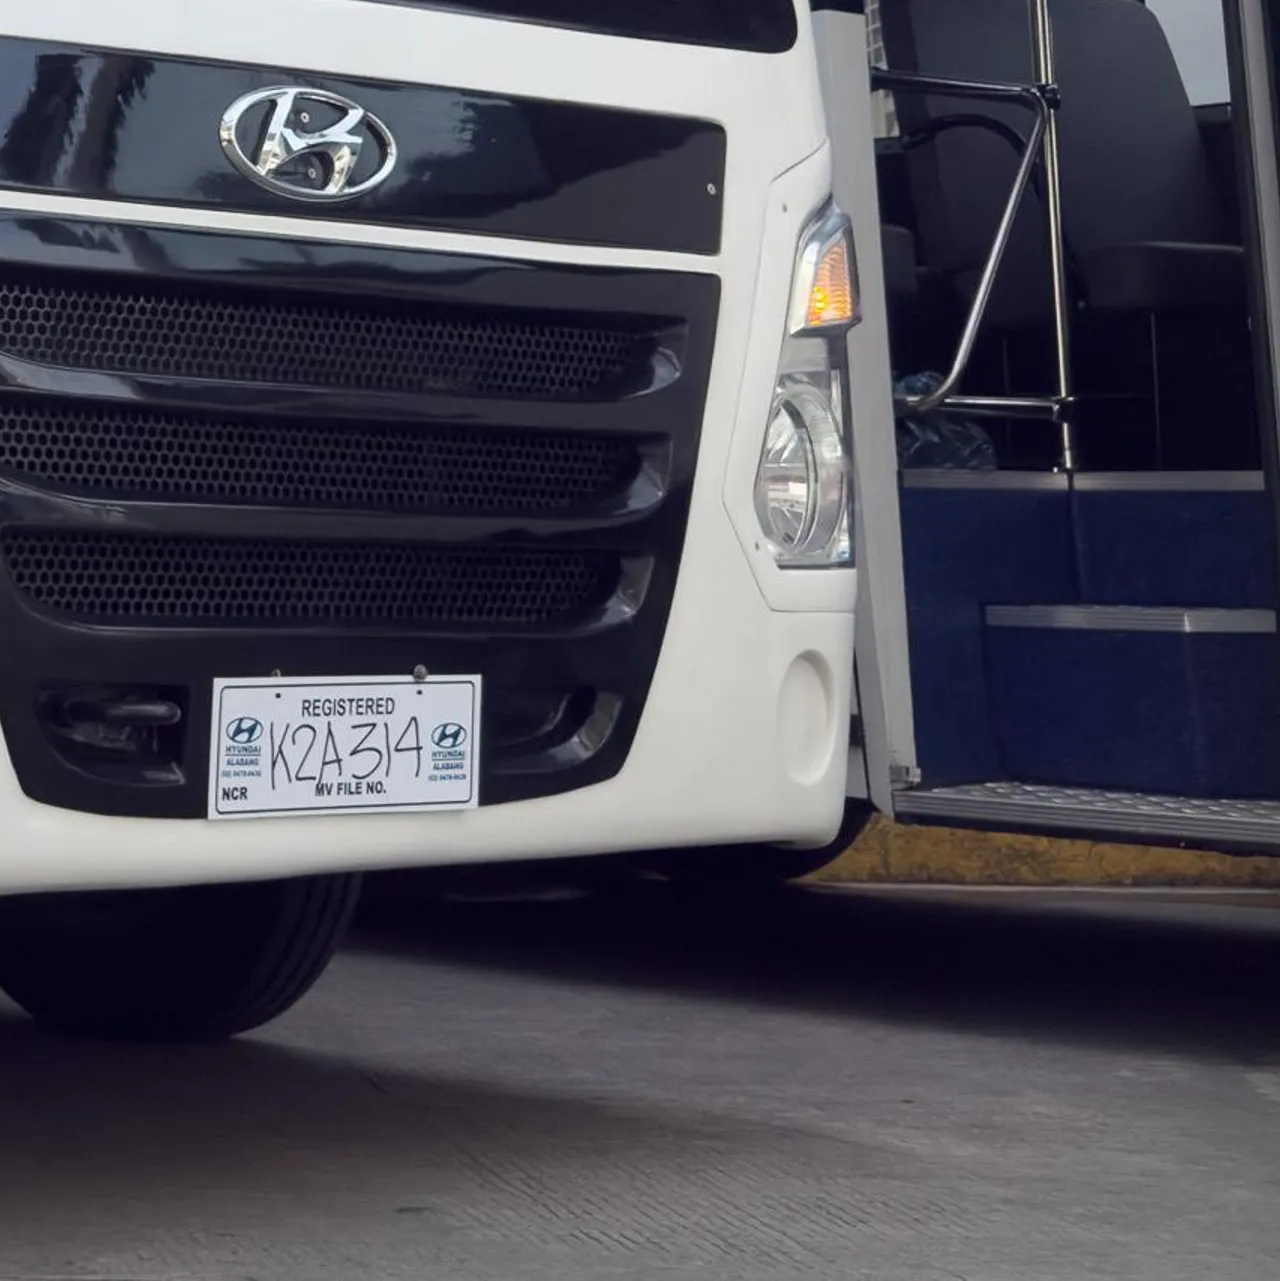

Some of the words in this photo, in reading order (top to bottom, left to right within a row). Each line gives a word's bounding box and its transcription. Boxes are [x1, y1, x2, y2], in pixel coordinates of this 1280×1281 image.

[302, 697, 395, 717] REGISTERED
[270, 716, 423, 790] K2A314
[222, 787, 248, 801] NCR
[315, 783, 333, 797] MV
[337, 781, 362, 796] FILE
[366, 780, 387, 794] NO.
